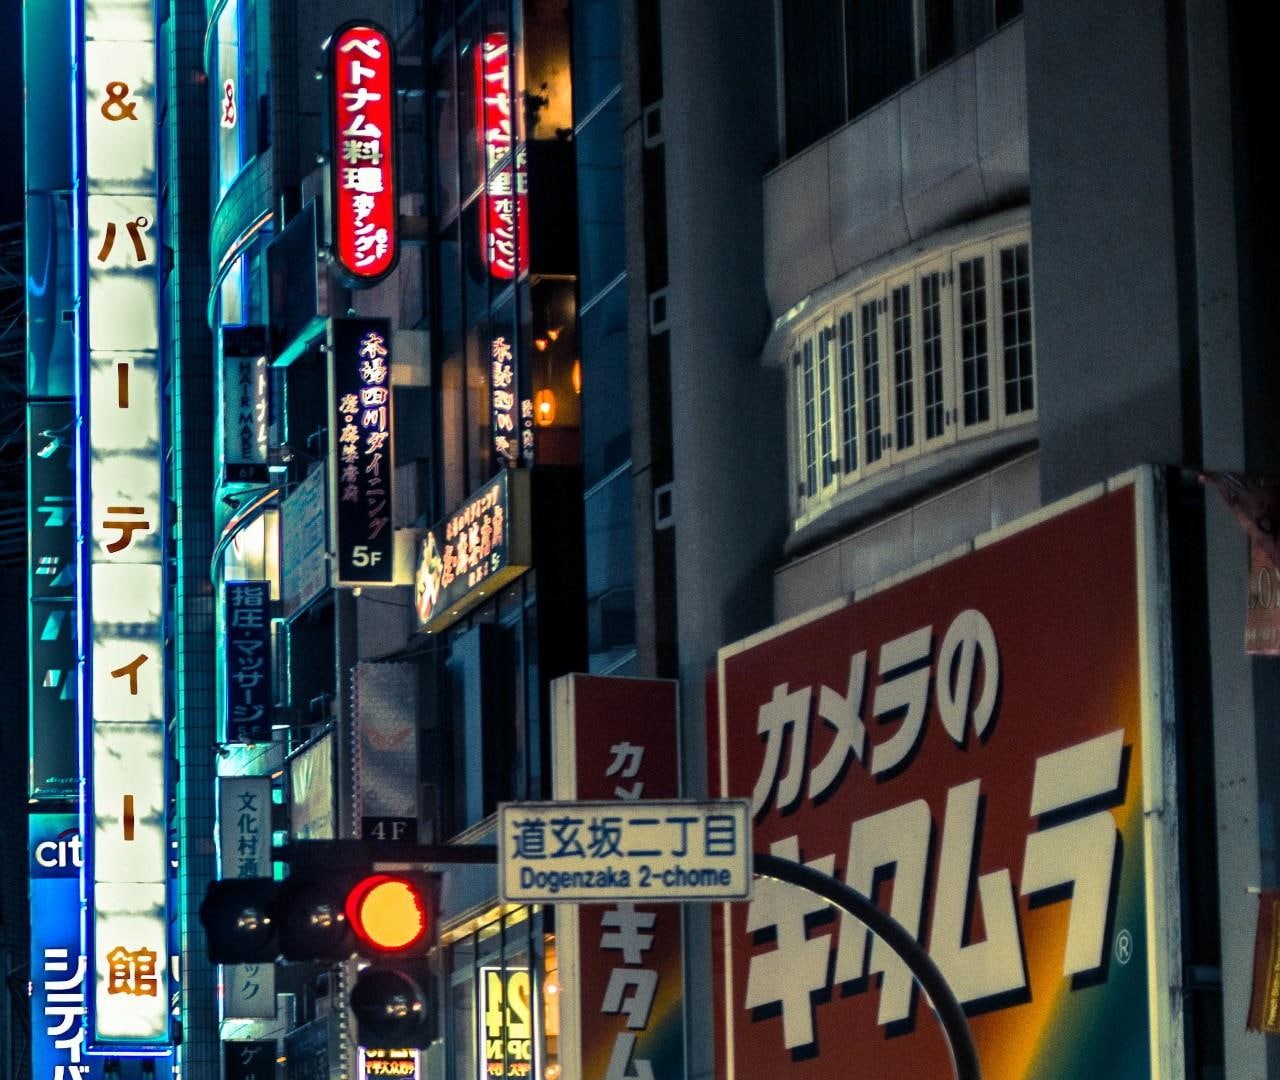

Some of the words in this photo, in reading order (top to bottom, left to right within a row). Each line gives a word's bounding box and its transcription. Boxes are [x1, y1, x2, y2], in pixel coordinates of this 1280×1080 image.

[340, 38, 384, 193] ベトナム料理
[353, 546, 382, 568] 5F
[752, 609, 1000, 822] カメラの
[371, 822, 408, 840] 4F
[512, 815, 737, 861] 道玄坂二丁目
[520, 865, 631, 893] Dogenzaka
[639, 865, 732, 889] 2-chome
[744, 728, 1125, 1050] キタムラ
